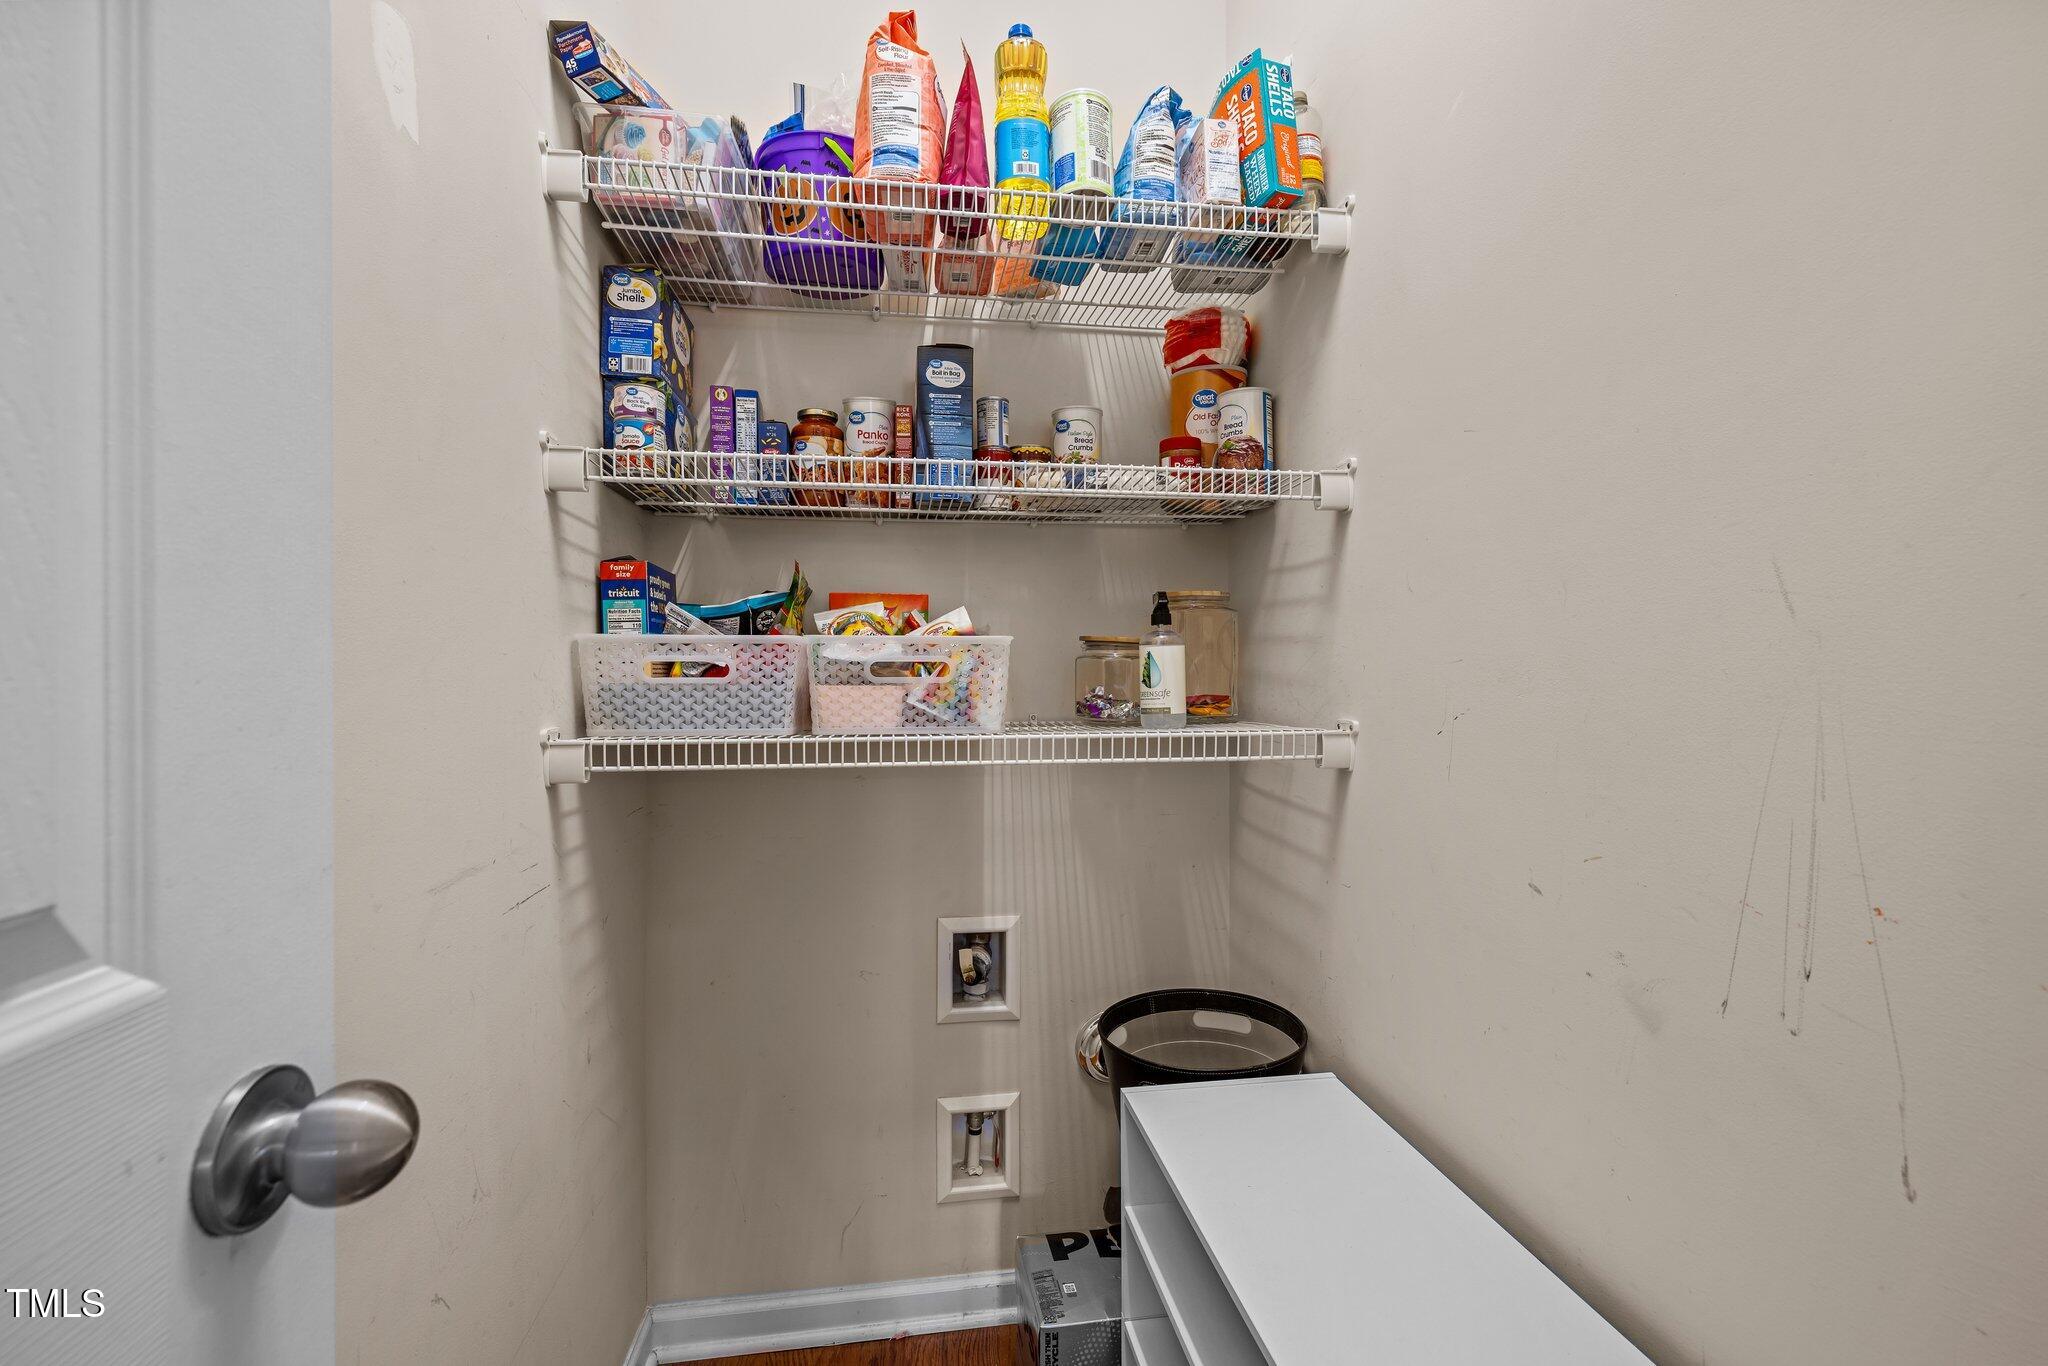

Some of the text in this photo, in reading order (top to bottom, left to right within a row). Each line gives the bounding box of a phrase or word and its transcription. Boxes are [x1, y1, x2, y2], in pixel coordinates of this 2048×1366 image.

[565, 58, 577, 69] 45
[1265, 63, 1283, 117] SHELLS
[1280, 86, 1295, 119] TACO
[1241, 101, 1257, 146] TACO
[1280, 131, 1296, 170] Original
[1250, 154, 1262, 198] WHEN
[1257, 148, 1270, 193] CRUNCHIER
[616, 292, 646, 303] Shells
[1194, 393, 1215, 402] Great
[1192, 412, 1206, 421] Old
[1223, 420, 1243, 431] Bread
[857, 429, 889, 441] Panko
[1073, 436, 1094, 444] Bread
[1220, 429, 1244, 440] Crumbs
[609, 563, 635, 571] family
[615, 570, 631, 578] size
[608, 589, 640, 597] triscuit
